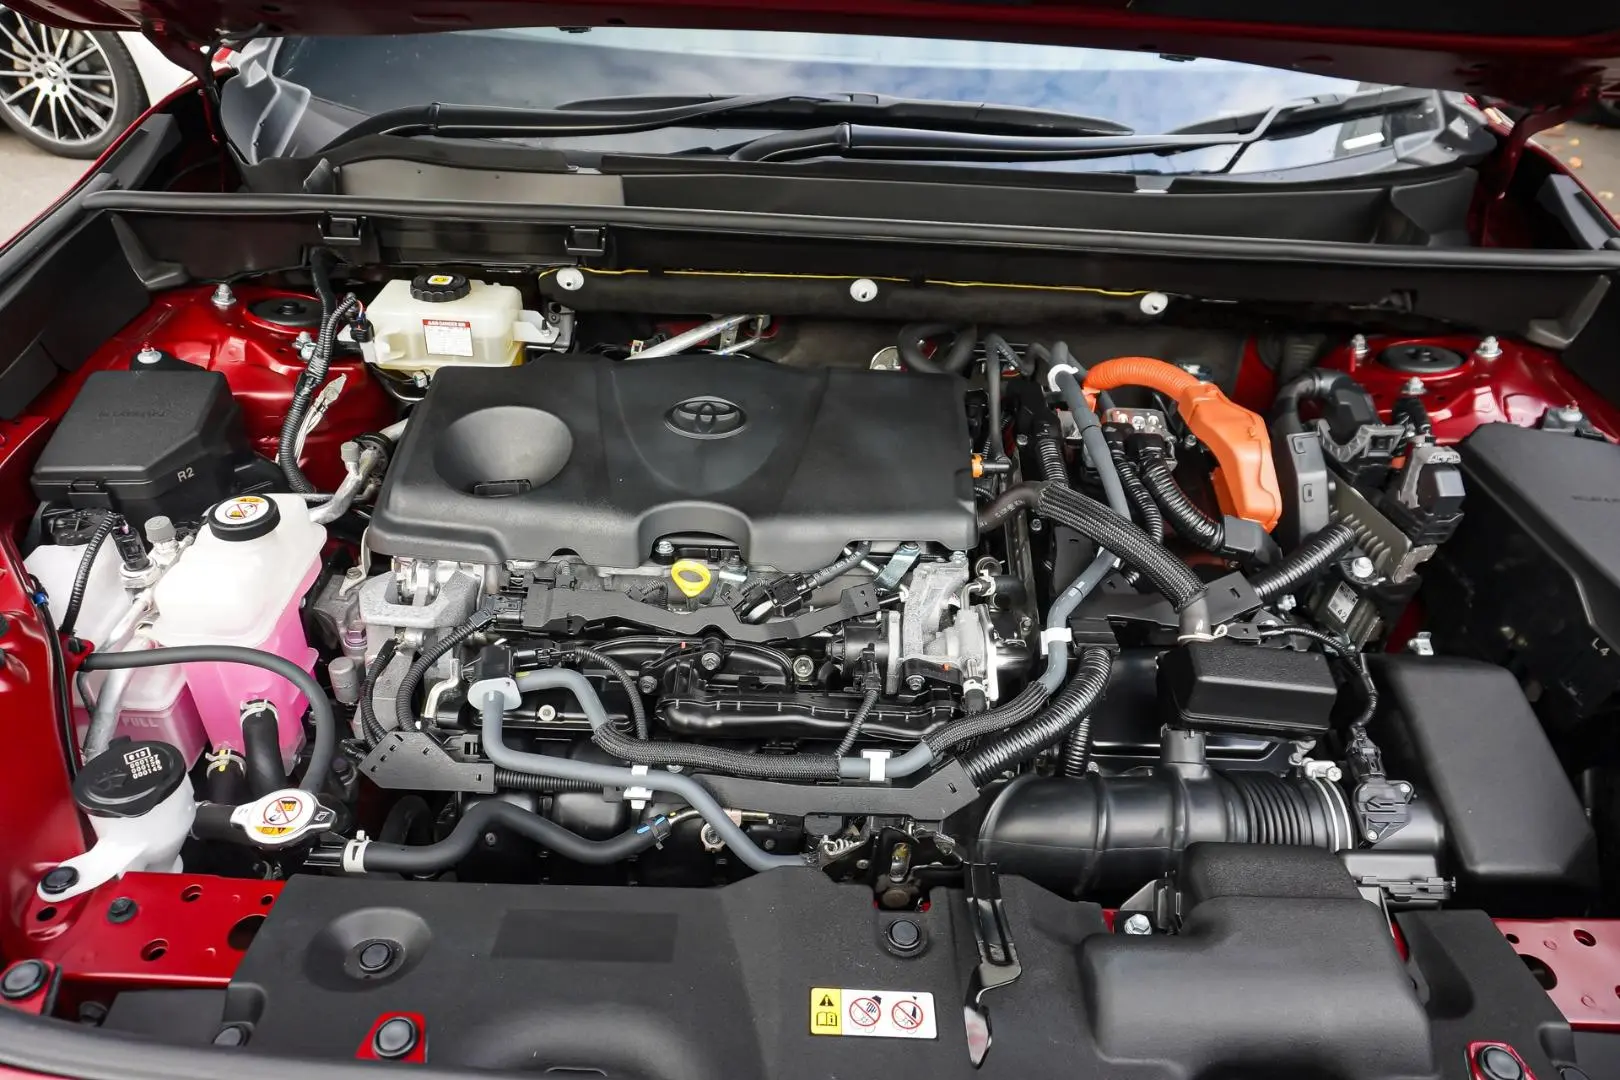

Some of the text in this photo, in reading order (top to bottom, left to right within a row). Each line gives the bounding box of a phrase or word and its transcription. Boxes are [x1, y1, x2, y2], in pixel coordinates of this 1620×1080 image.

[177, 467, 195, 482] R2
[1592, 637, 1610, 656] L4
[130, 754, 159, 769] 000127
